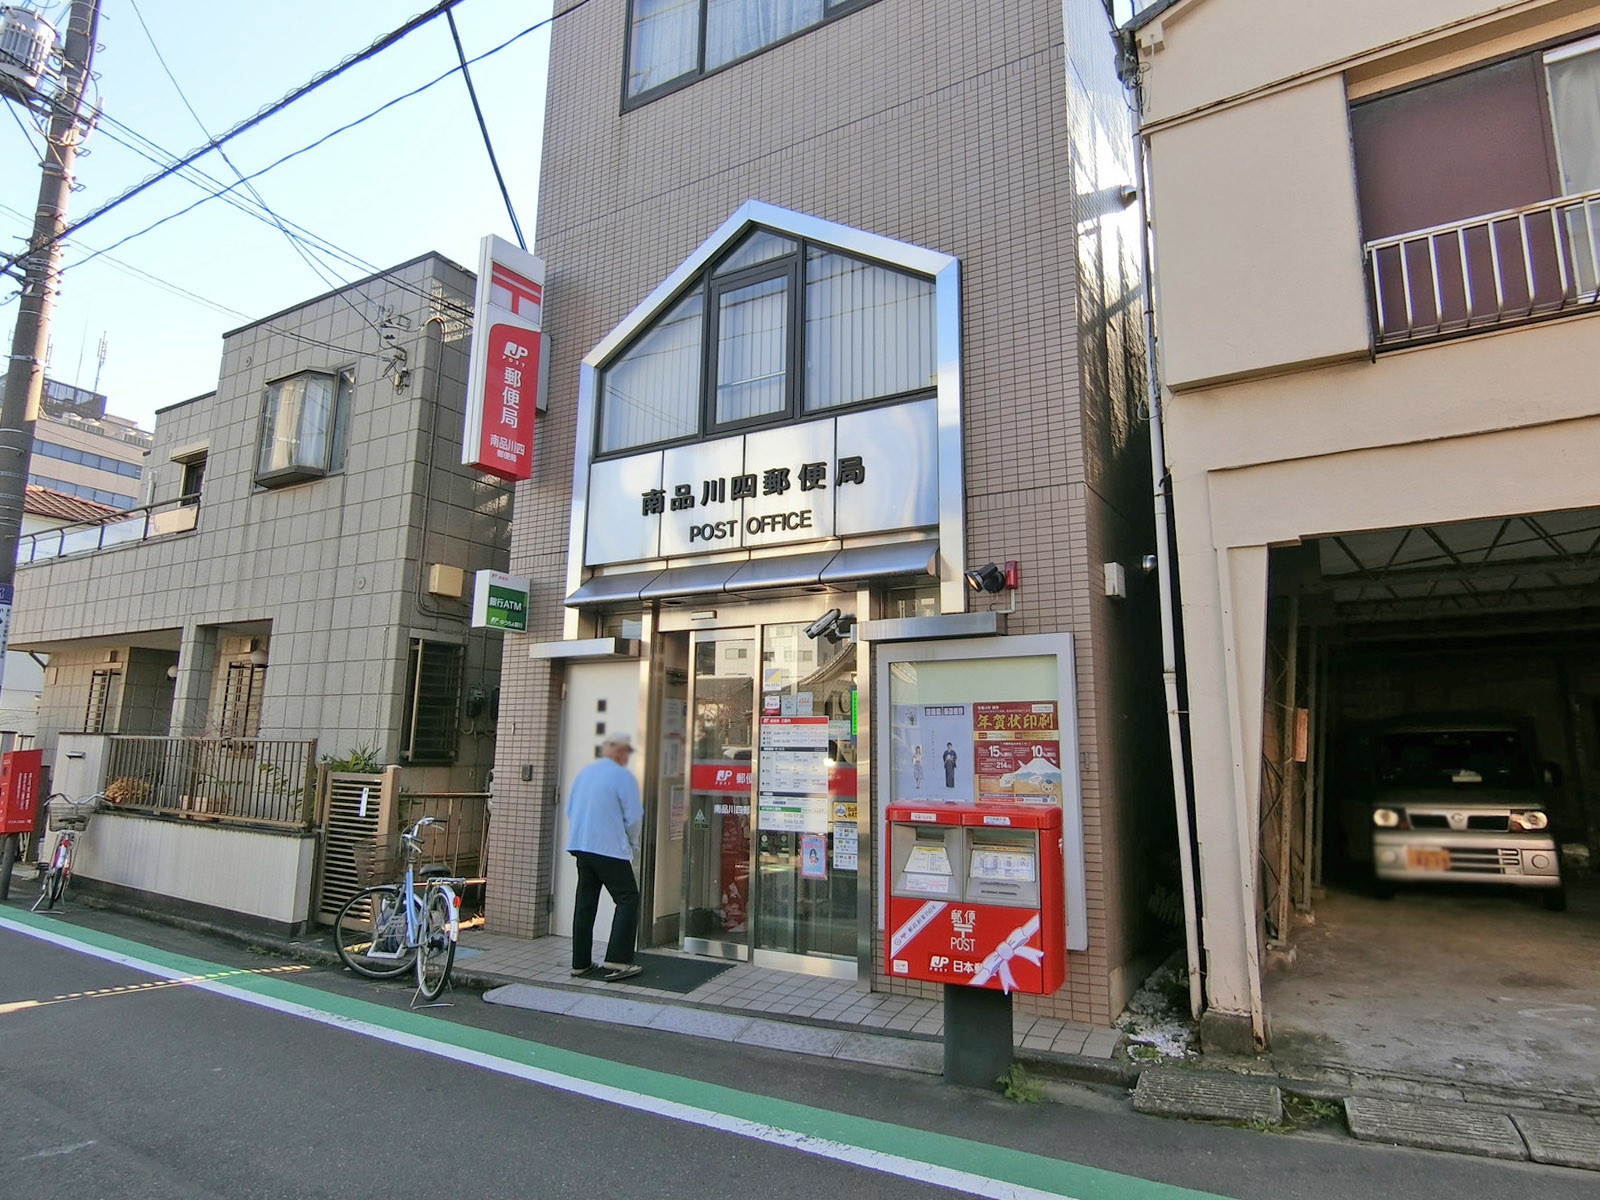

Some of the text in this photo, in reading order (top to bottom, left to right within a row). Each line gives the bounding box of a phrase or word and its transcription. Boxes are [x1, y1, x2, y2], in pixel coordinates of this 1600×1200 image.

[502, 355, 526, 368] POST
[500, 367, 522, 429] 郵便局
[490, 434, 525, 456] 南品川四
[496, 449, 517, 463] 郵便局
[641, 455, 866, 516] 南品川四郵便局
[689, 509, 812, 543] POST OFFICE
[489, 596, 522, 612] 銀行ATM
[977, 713, 1054, 730] 年賀状印刷
[950, 909, 976, 926] 郵便
[950, 936, 976, 952] POST
[929, 955, 950, 968] JP
